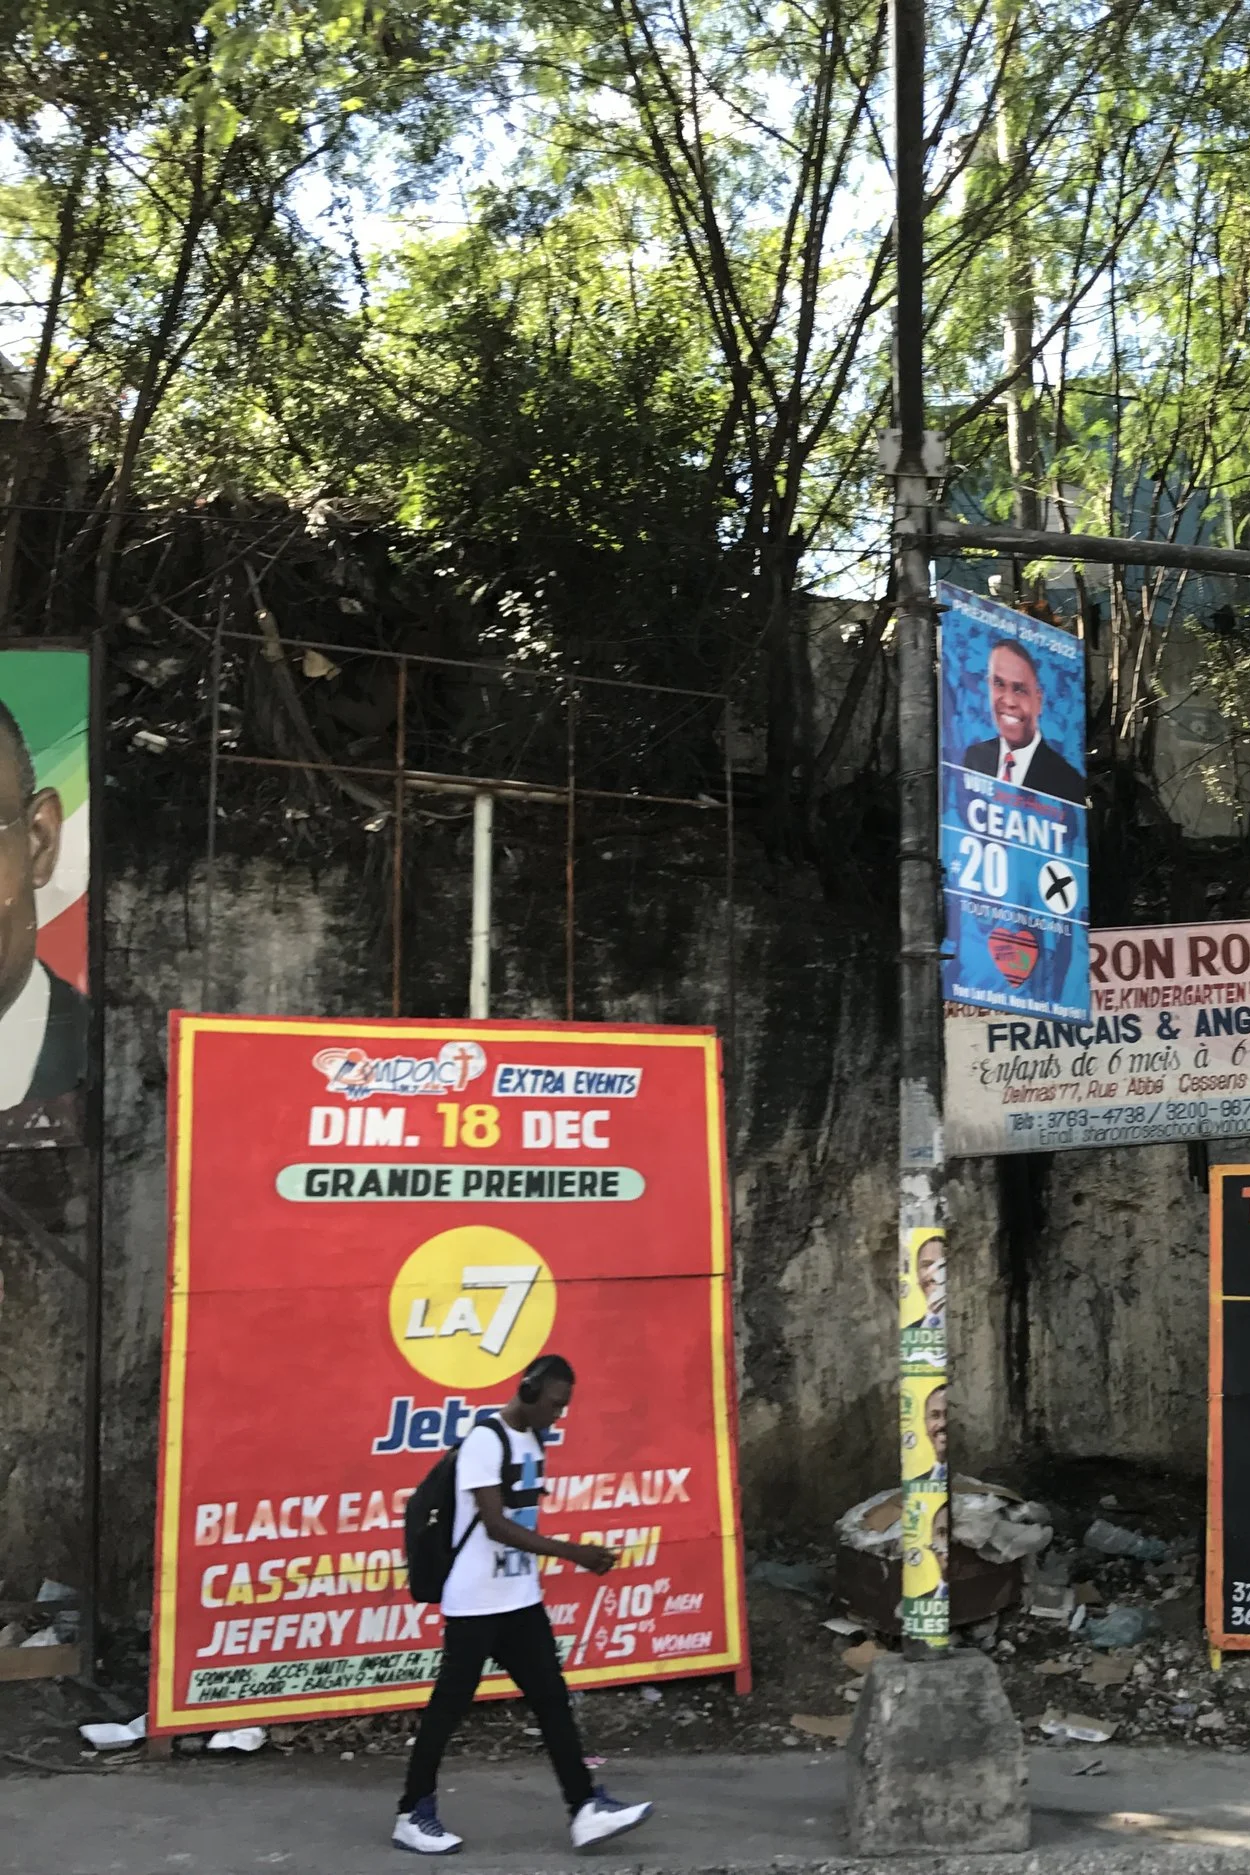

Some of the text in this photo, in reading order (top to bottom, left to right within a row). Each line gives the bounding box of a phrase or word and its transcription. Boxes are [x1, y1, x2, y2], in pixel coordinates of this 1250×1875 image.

[967, 799, 1067, 853] CEANT
[1157, 1011, 1181, 1041] &
[1109, 1048, 1125, 1074] 6
[1129, 1045, 1181, 1073] mois
[498, 1068, 637, 1094] EXTRA EVENTS
[1086, 1080, 1117, 1099] Rue
[309, 1103, 610, 1148] DIM. 18 DEC
[304, 1168, 619, 1197] GRANDE PREMIERE
[196, 1494, 328, 1546] BLACK
[541, 1467, 692, 1514] UMEAUX
[664, 1593, 704, 1612] MEN
[197, 1609, 346, 1658] JEFFRY
[652, 1632, 712, 1654] WOMEN
